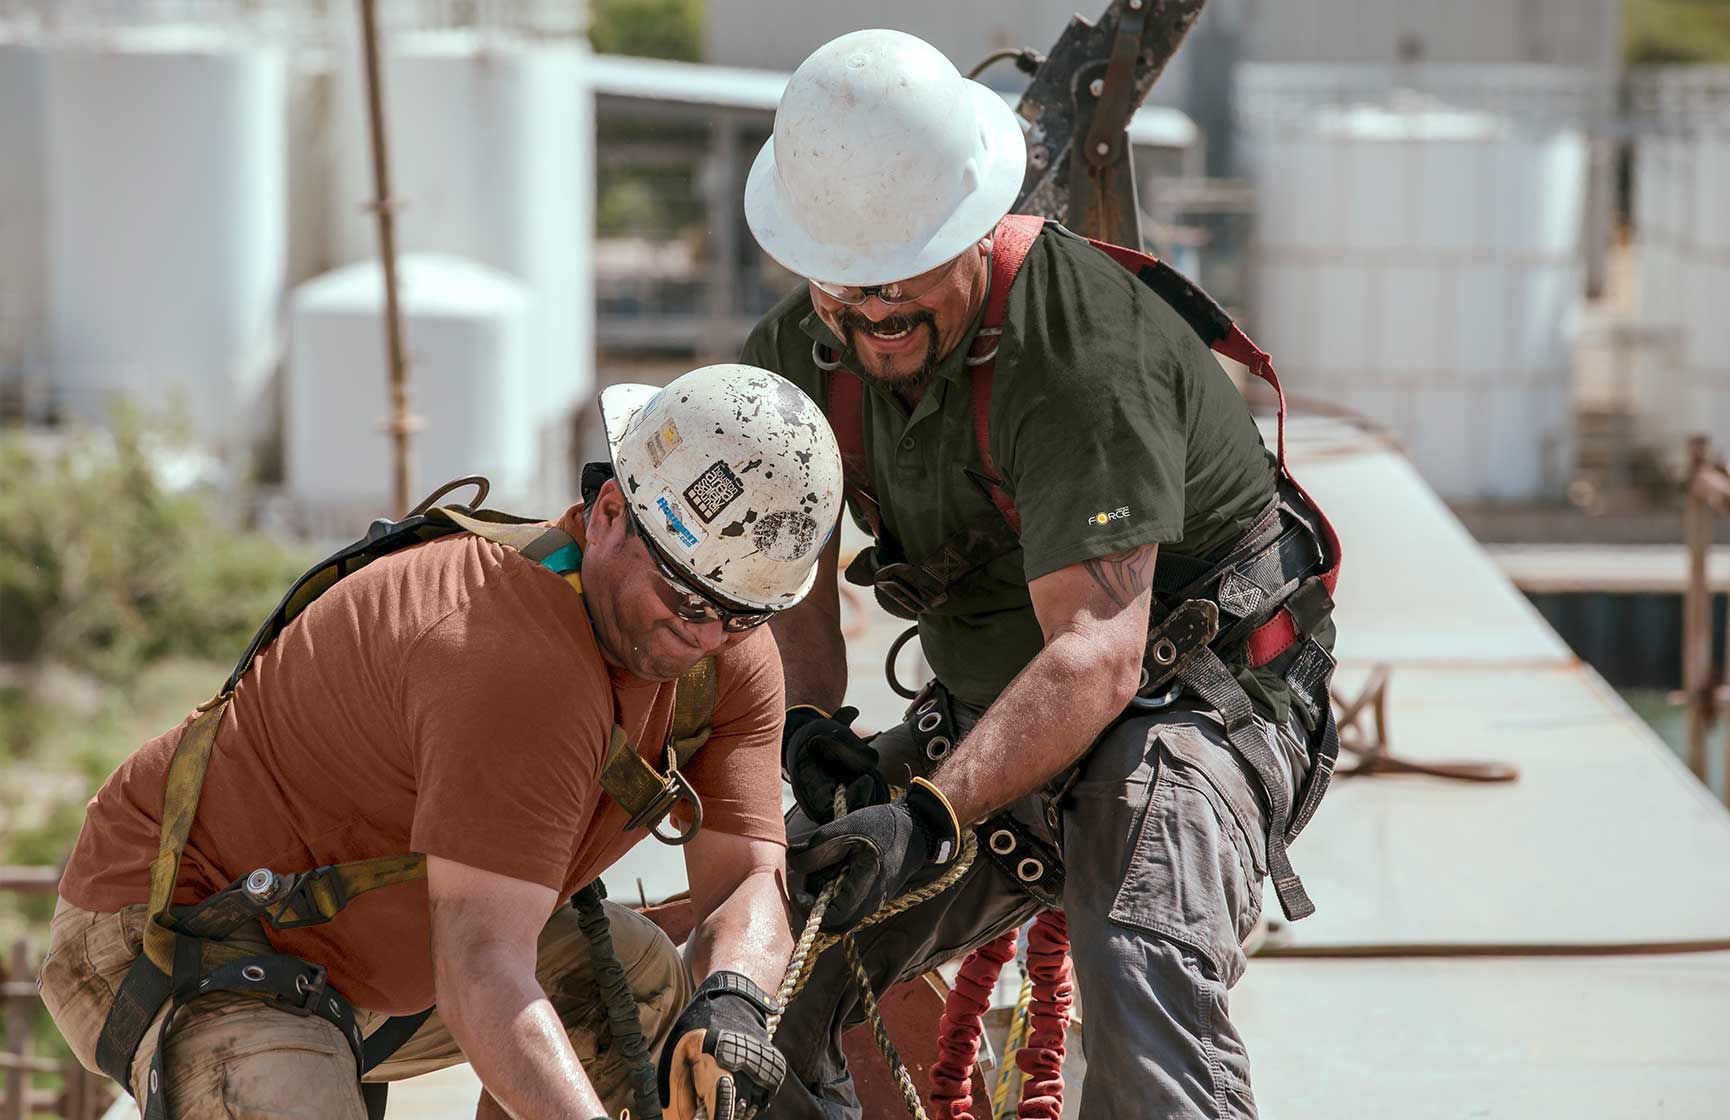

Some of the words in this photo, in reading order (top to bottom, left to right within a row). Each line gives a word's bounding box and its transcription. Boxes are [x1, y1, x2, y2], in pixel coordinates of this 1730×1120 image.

[704, 470, 734, 501] area
[713, 465, 738, 494] houston
[1088, 508, 1131, 526] FORCE
